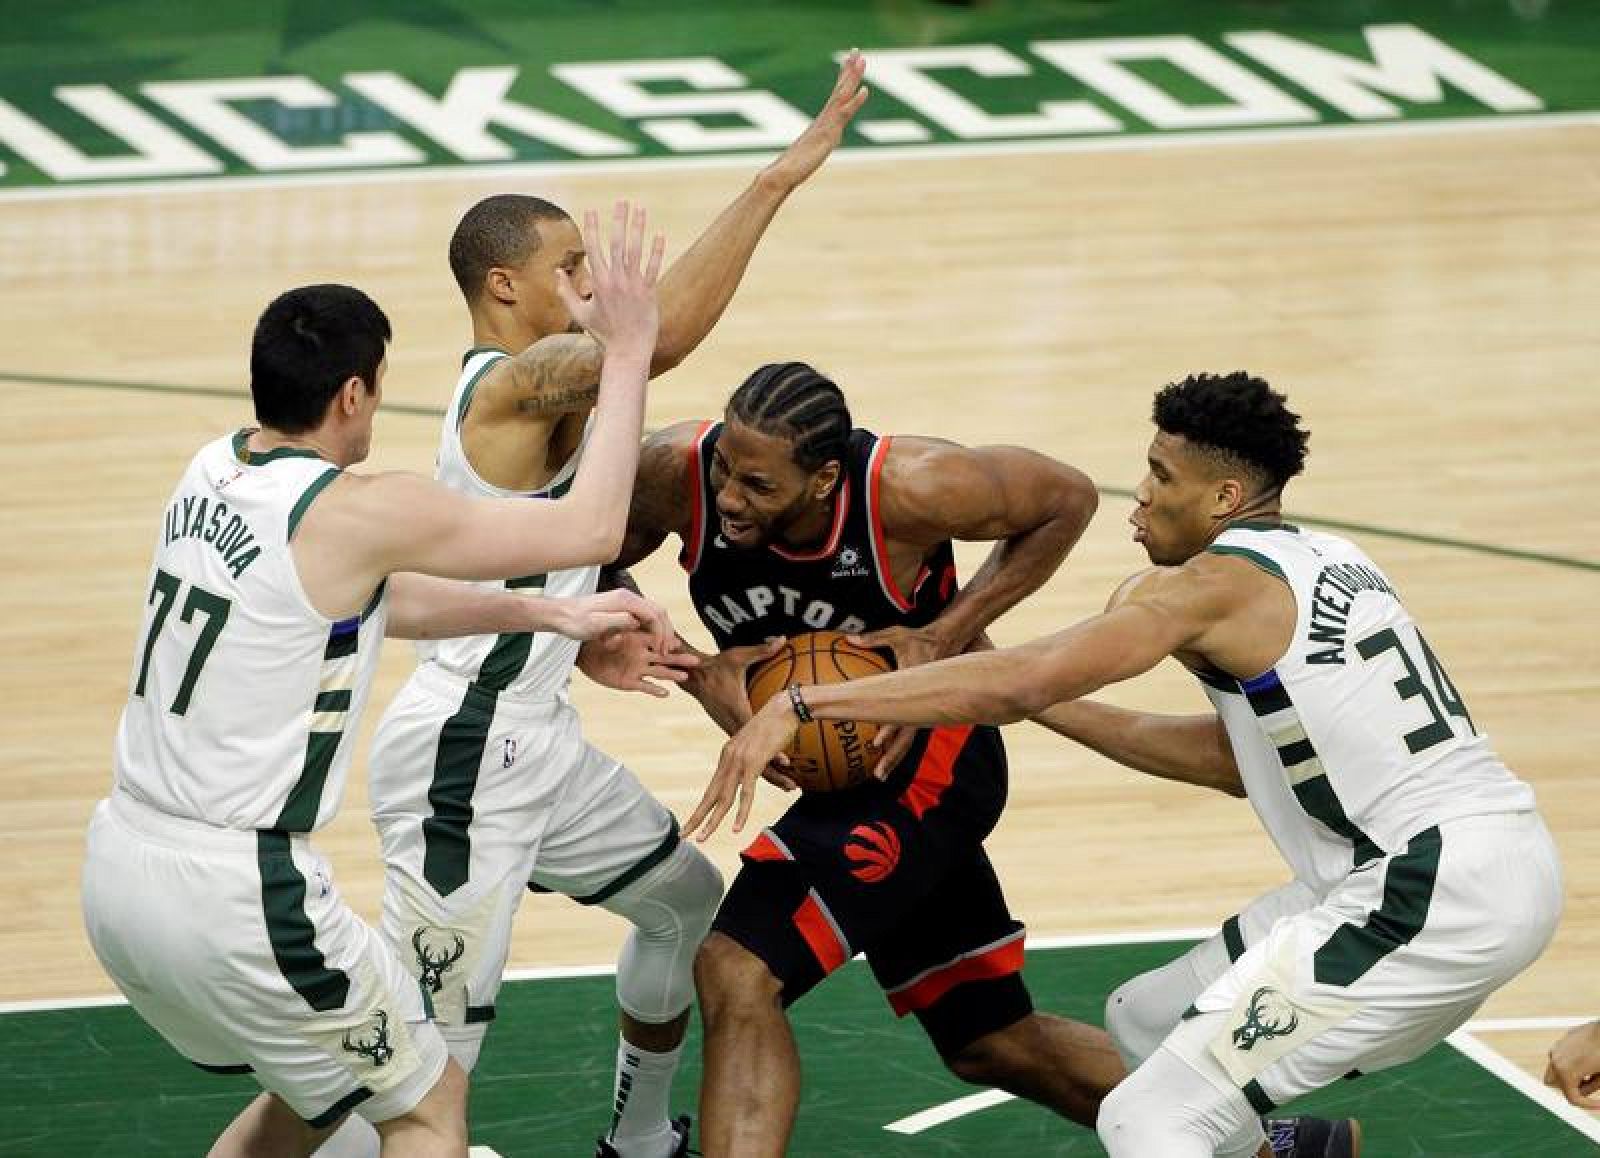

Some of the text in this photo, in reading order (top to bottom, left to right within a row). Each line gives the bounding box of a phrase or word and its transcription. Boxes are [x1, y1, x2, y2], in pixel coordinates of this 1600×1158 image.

[0, 25, 1544, 181] UCKS.COM
[165, 495, 262, 580] ILYASOVA
[134, 567, 232, 717] 77
[703, 585, 866, 635] RAPTOR
[1354, 625, 1477, 755] 34
